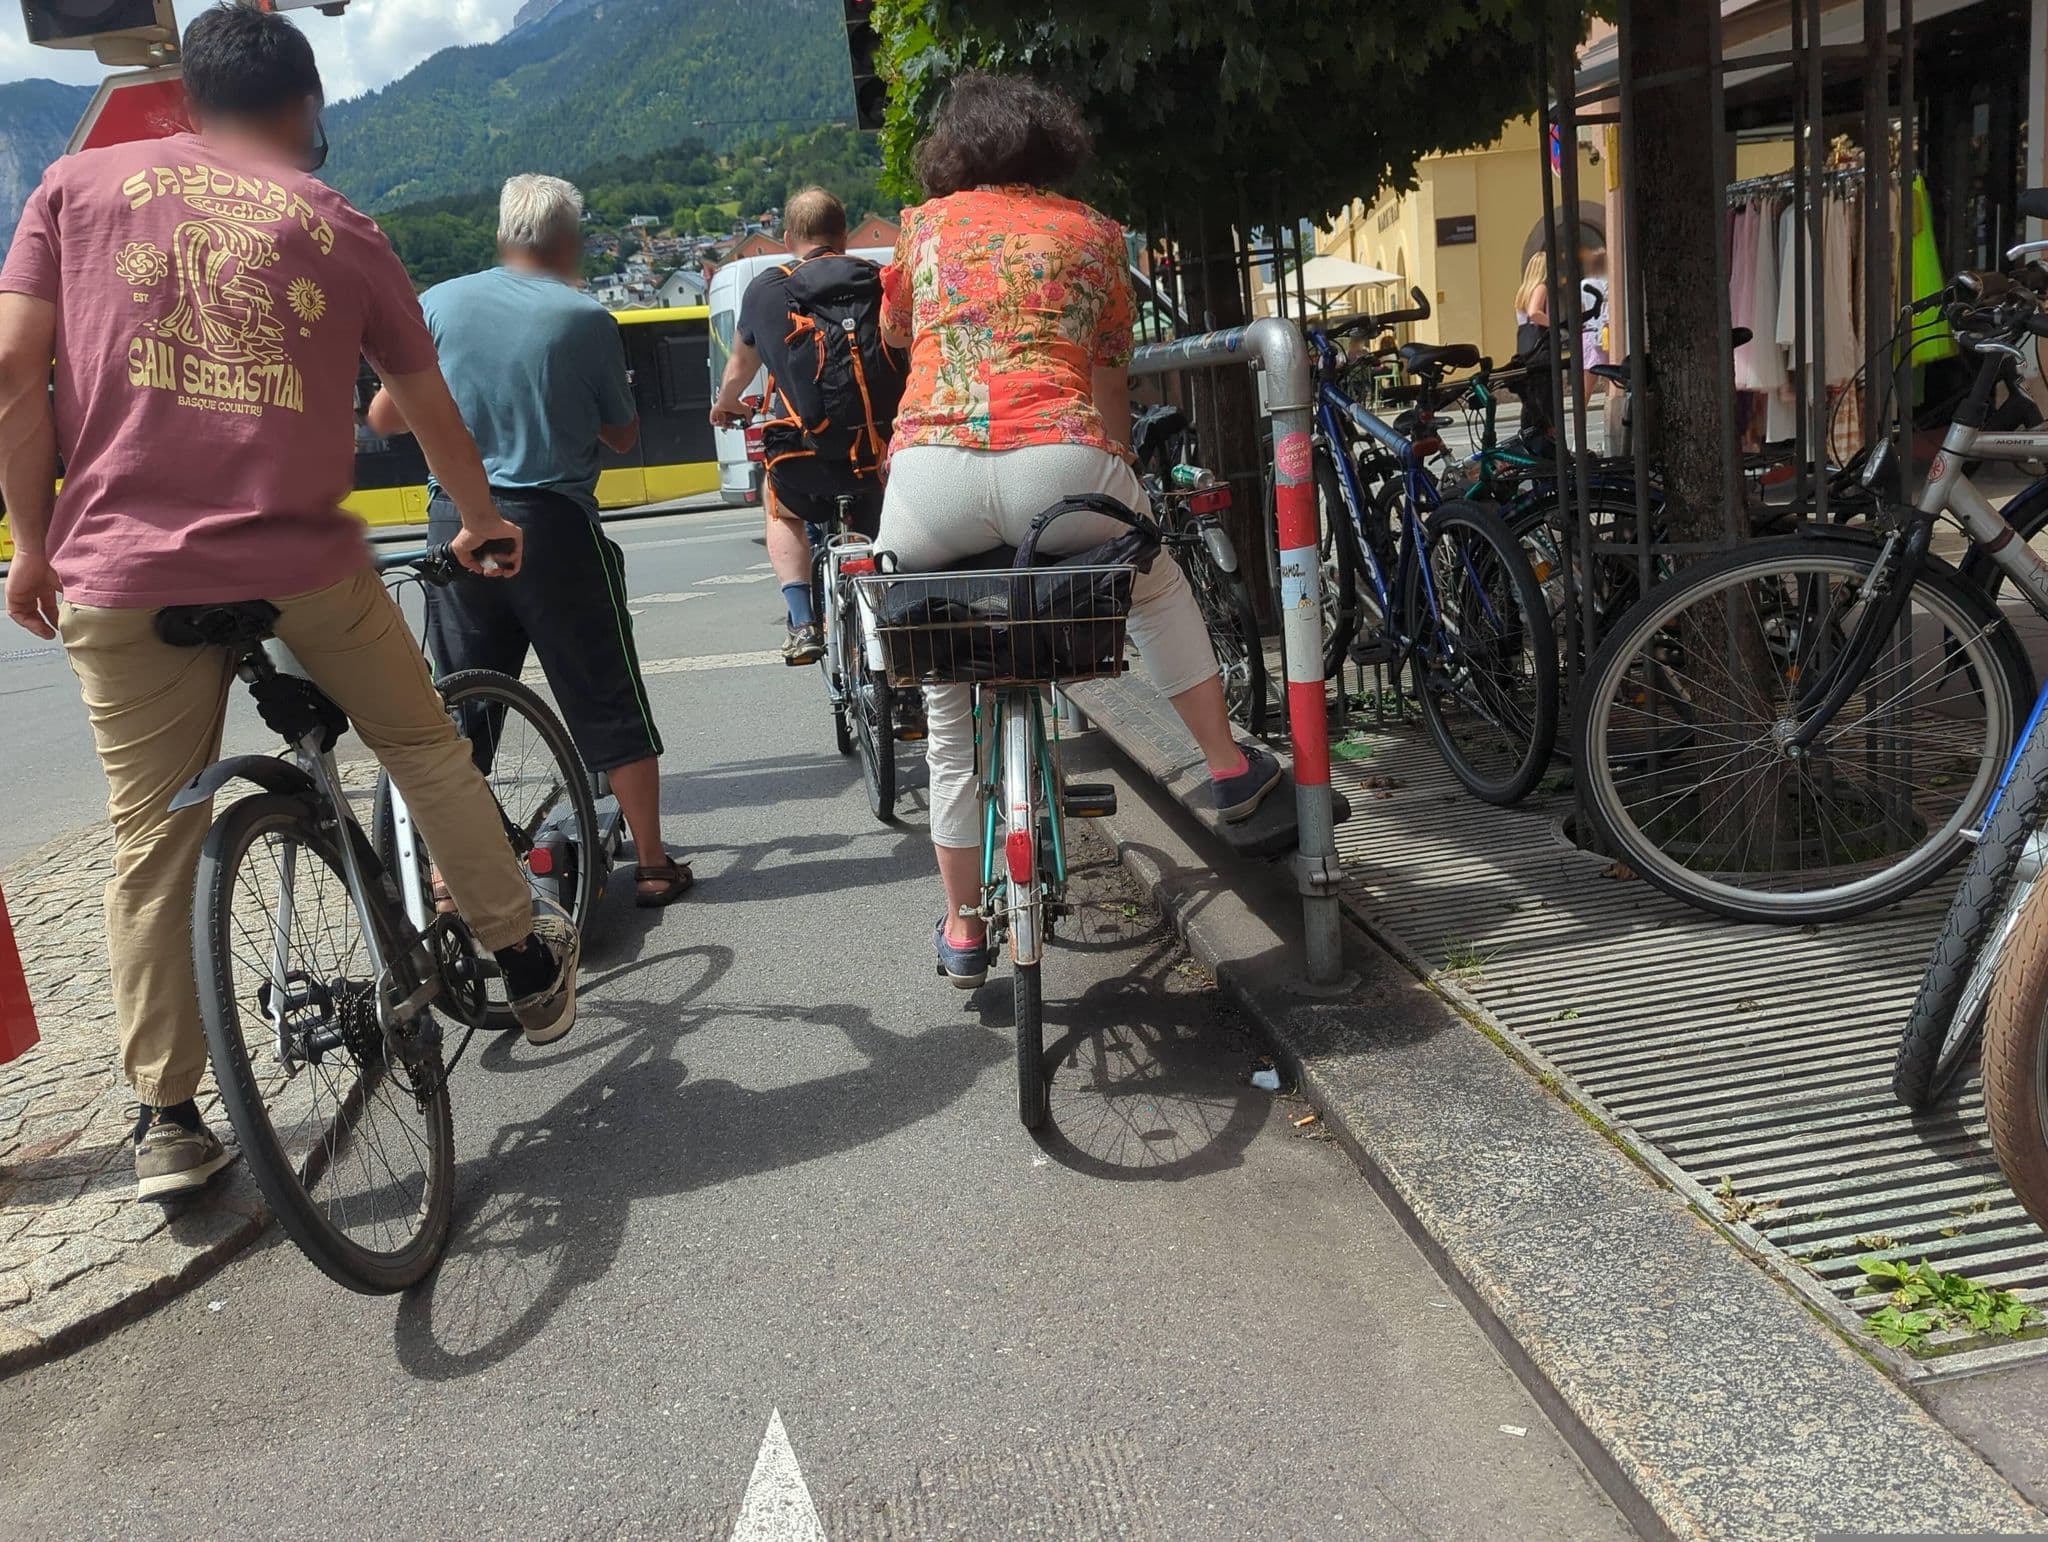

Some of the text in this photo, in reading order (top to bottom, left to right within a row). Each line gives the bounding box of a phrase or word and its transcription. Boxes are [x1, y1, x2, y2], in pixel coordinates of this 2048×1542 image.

[122, 164, 335, 256] SAYONARA
[128, 336, 304, 412] SAN SEBASTIAN
[177, 395, 263, 417] BASQUE COUNTRY
